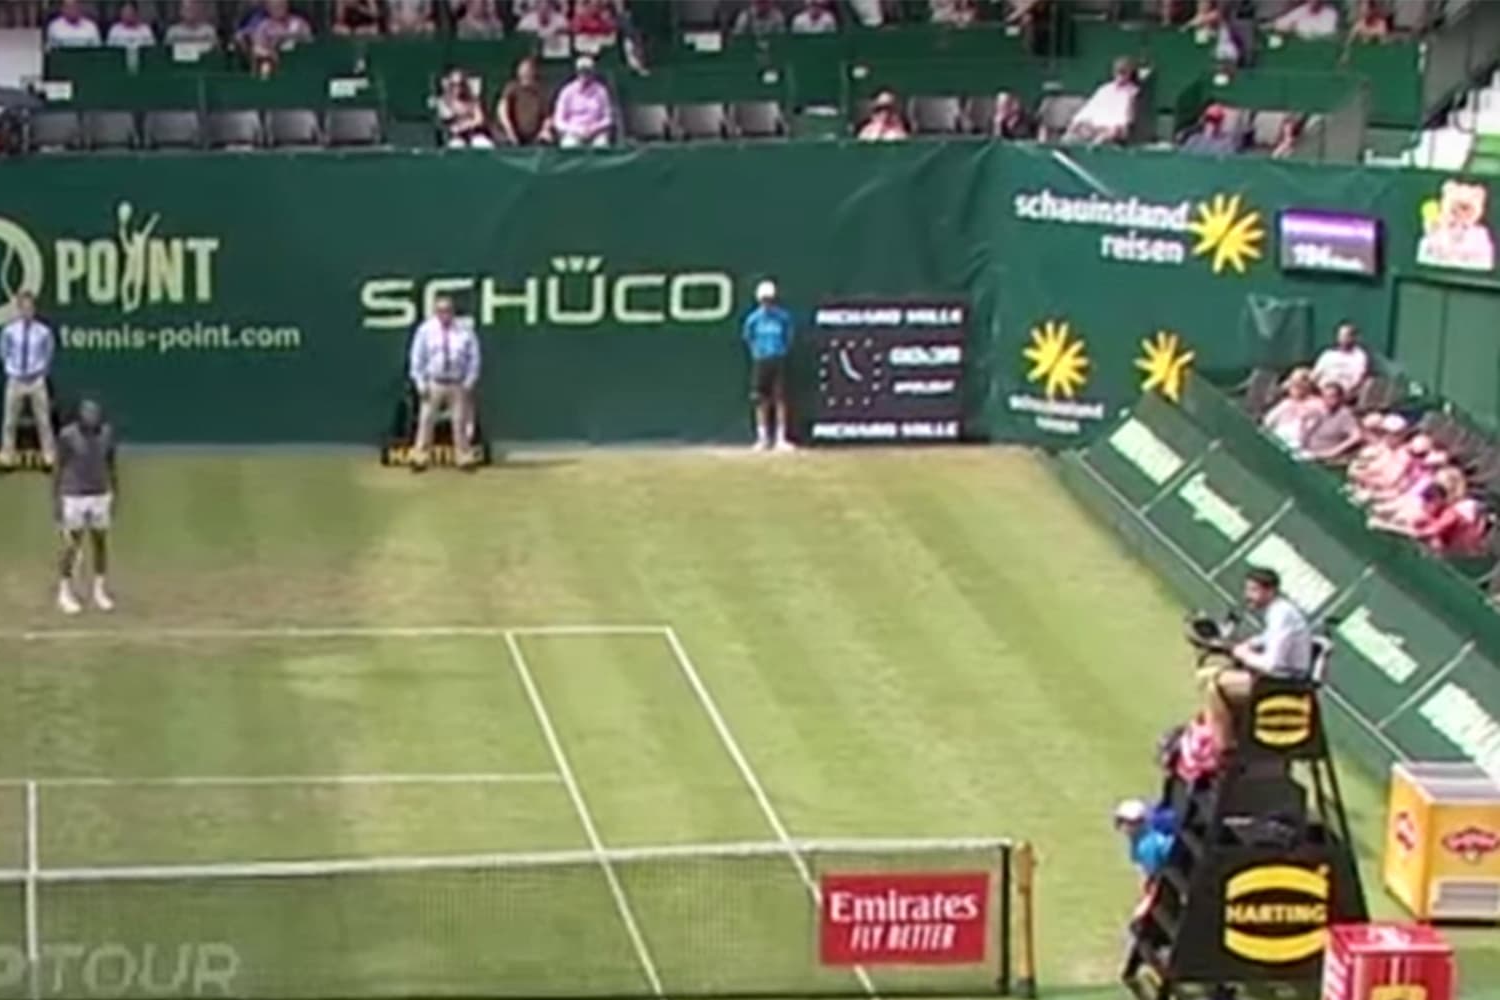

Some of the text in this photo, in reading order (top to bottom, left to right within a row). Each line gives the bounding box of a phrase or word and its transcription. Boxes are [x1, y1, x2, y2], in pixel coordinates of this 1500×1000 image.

[1102, 230, 1185, 264] reisen
[59, 322, 301, 354] tennis-point.com
[830, 889, 979, 923] Emirates
[1225, 902, 1328, 924] HARTING
[851, 922, 956, 951] FLY BETTER
[41, 941, 240, 997] TOUR
